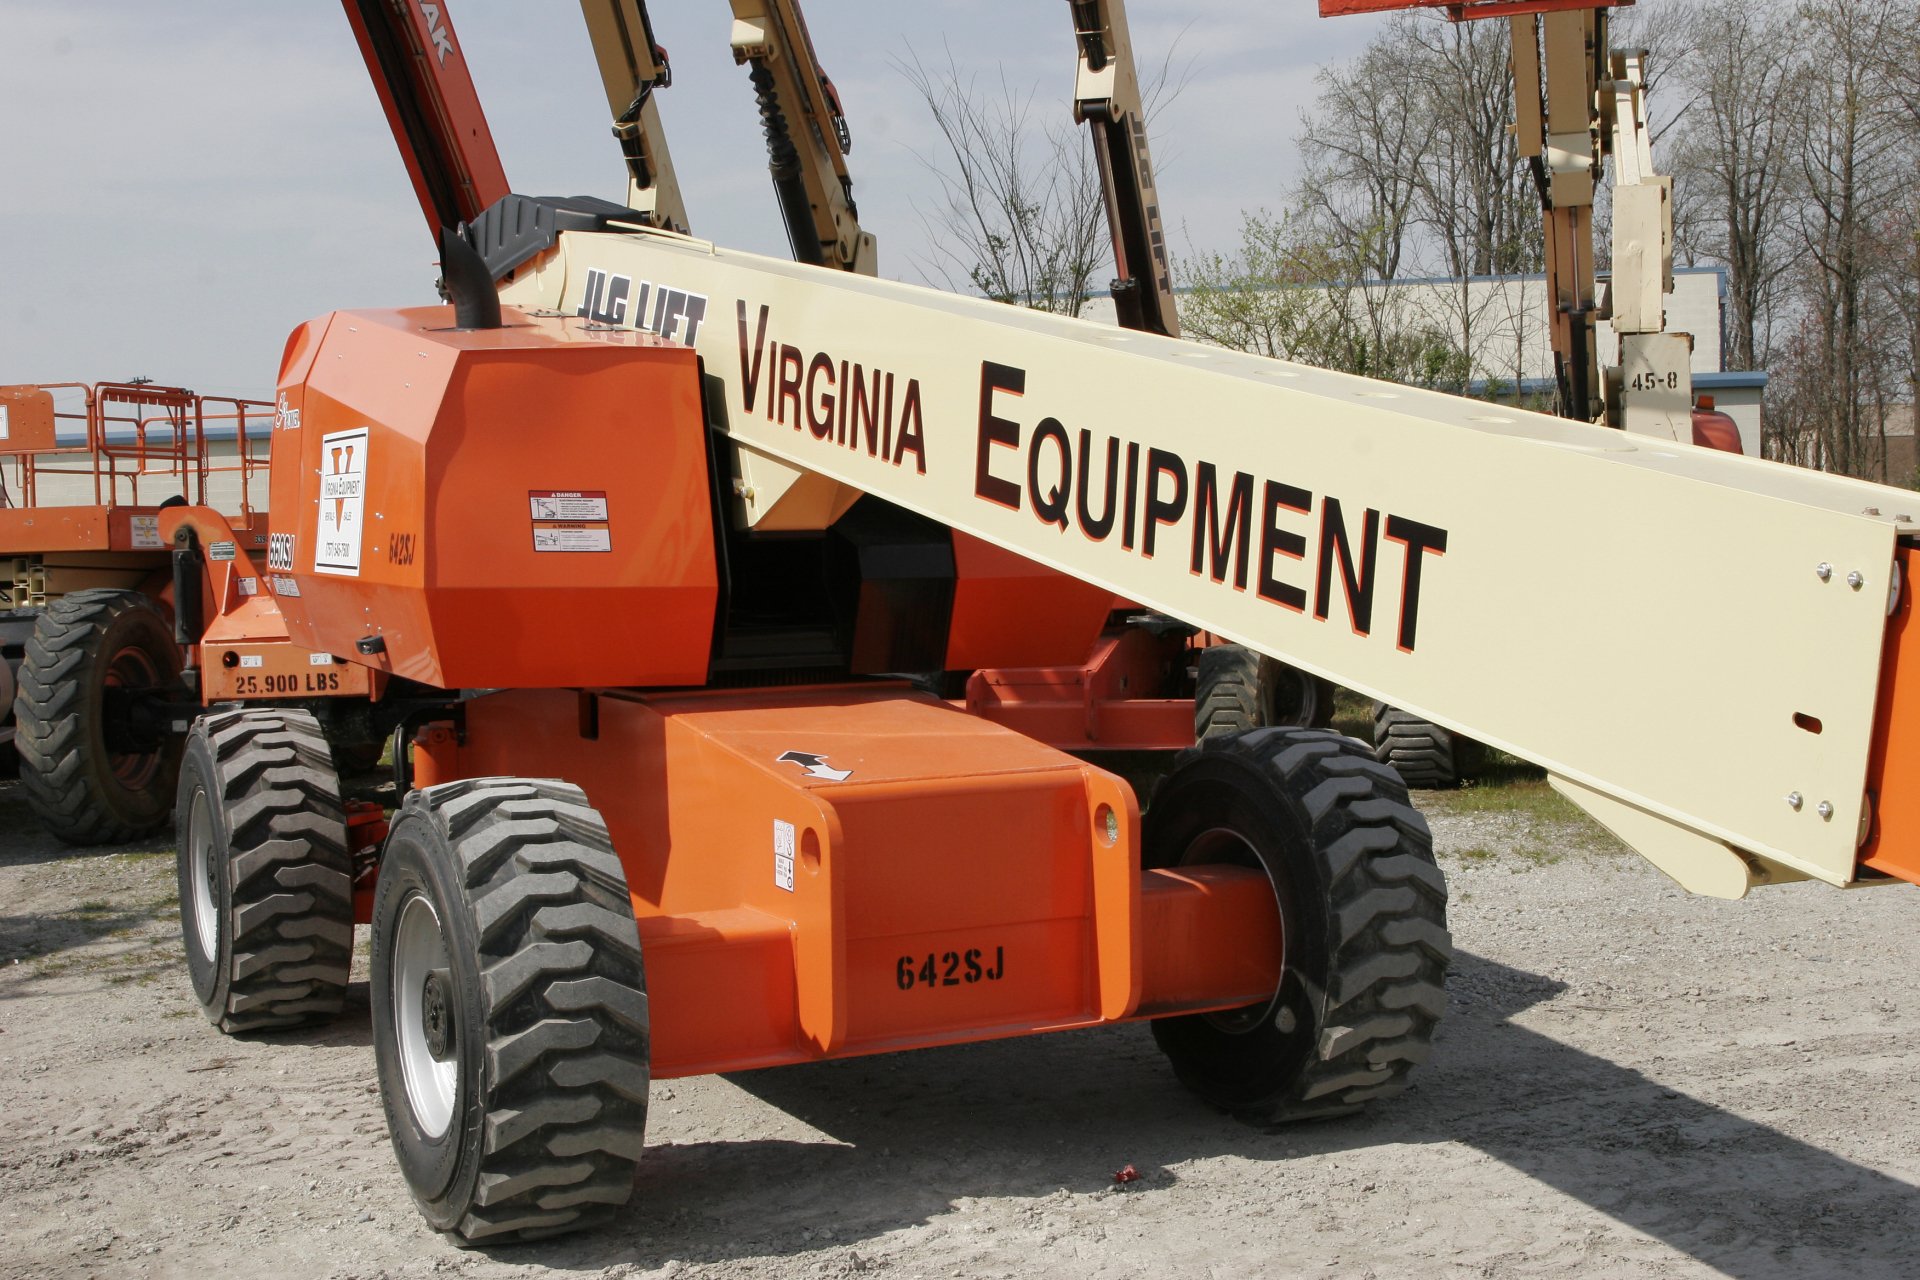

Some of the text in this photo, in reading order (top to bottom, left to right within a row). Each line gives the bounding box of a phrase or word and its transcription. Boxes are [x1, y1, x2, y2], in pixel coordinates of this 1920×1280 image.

[1129, 111, 1171, 296] JLG LIFT
[576, 267, 709, 348] JLG LIFT
[1631, 371, 1678, 392] 45-8
[736, 298, 1448, 655] VIRGINIA EQUIPMENT
[268, 532, 295, 571] 660SJ
[389, 533, 416, 566] 642SJ
[306, 672, 339, 691] LBS
[896, 946, 1003, 990] 642SJ
